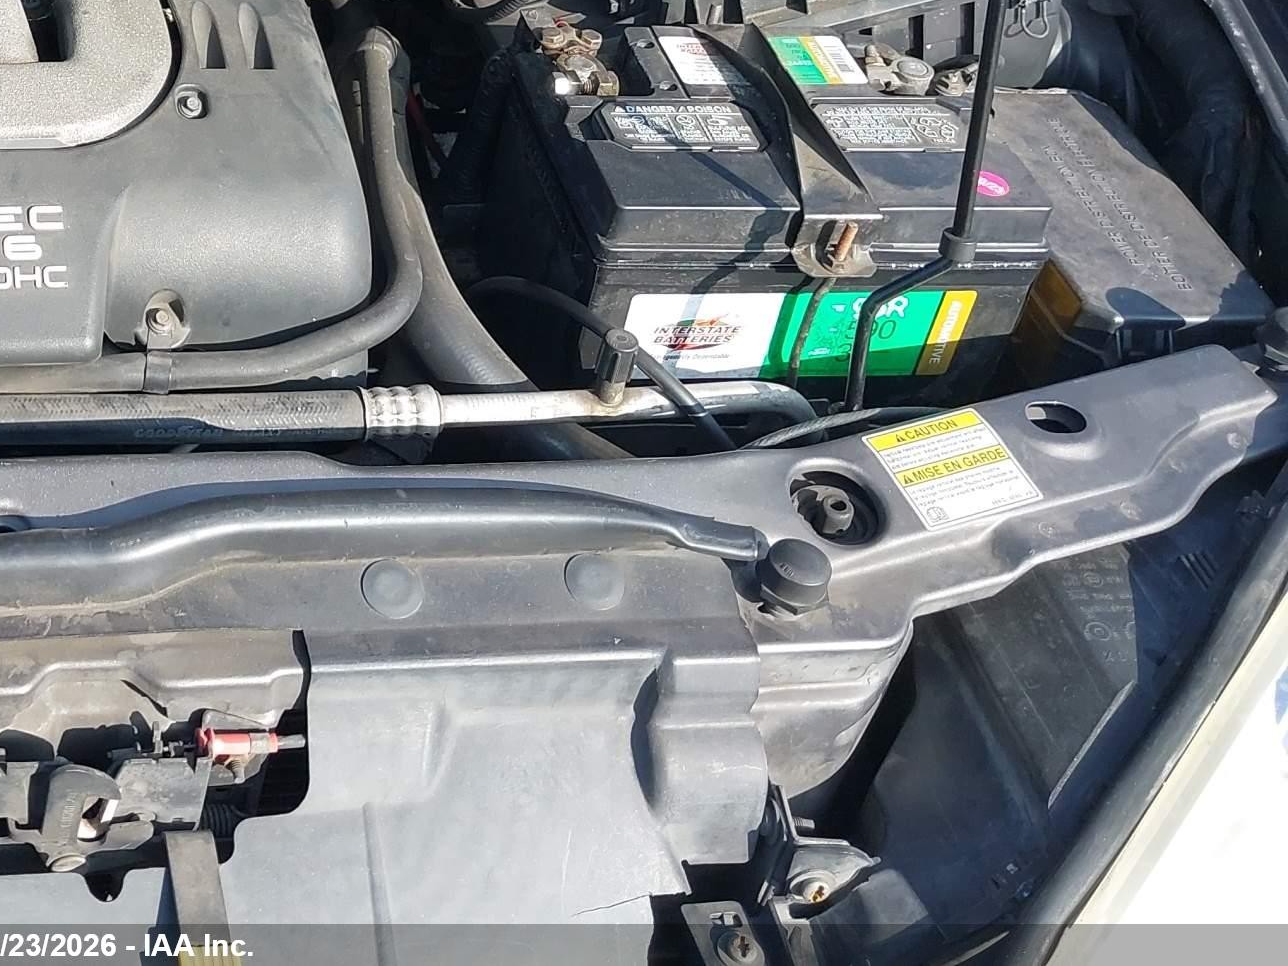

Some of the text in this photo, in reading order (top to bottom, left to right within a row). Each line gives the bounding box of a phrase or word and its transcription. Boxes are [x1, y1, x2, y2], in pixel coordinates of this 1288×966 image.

[626, 105, 676, 113] DANGER
[686, 105, 731, 113] POISON
[654, 325, 741, 334] INTERSTATE
[654, 335, 732, 344] BATTERIES
[905, 419, 958, 440] CAUTION
[913, 463, 944, 482] MISE
[945, 457, 963, 473] EN
[963, 448, 1006, 467] GARDE
